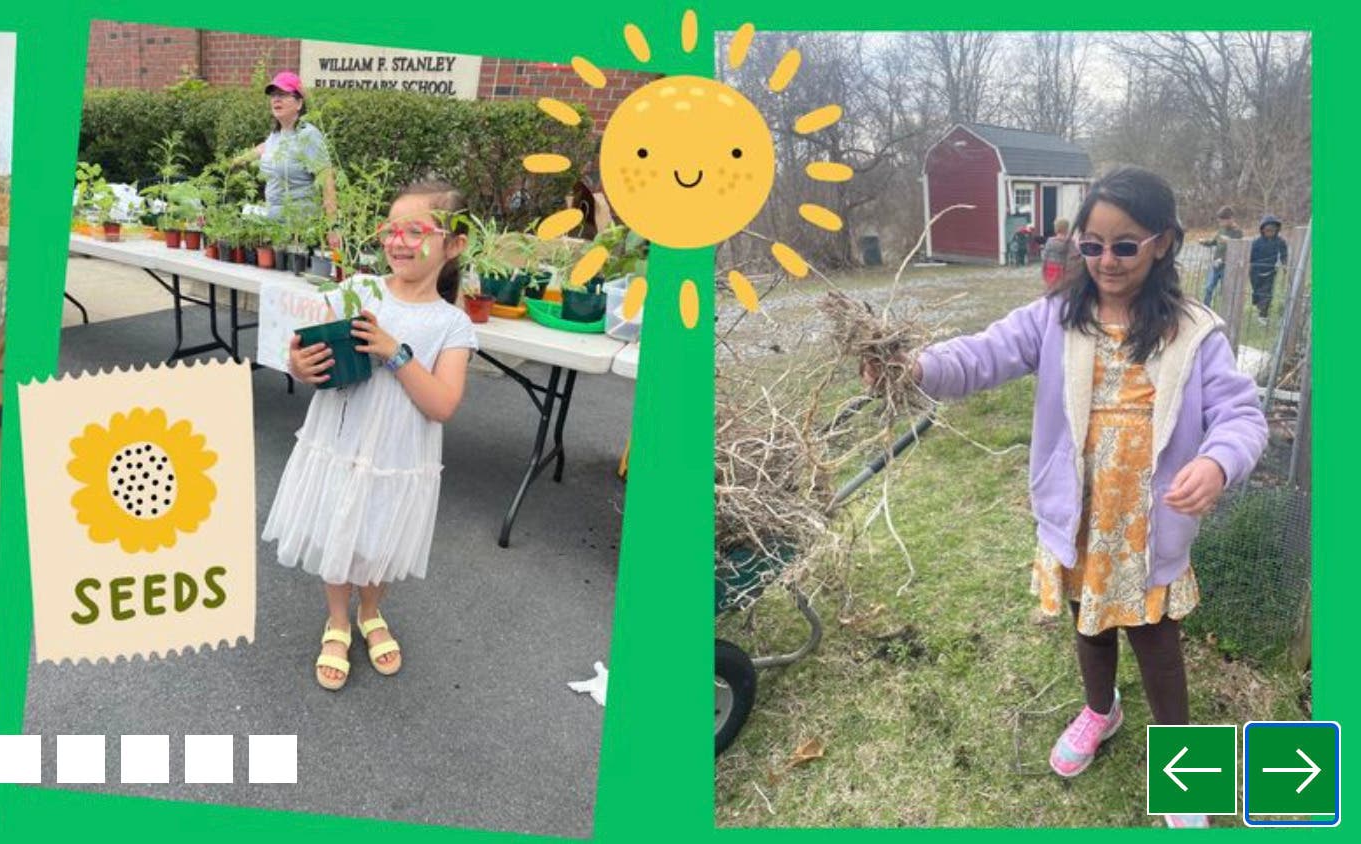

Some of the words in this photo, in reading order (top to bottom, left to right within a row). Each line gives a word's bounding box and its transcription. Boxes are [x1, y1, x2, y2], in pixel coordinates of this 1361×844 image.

[319, 57, 373, 72] WILLIAM
[378, 58, 388, 72] F.
[392, 56, 456, 72] STANLEY
[401, 80, 456, 95] SCHOOL
